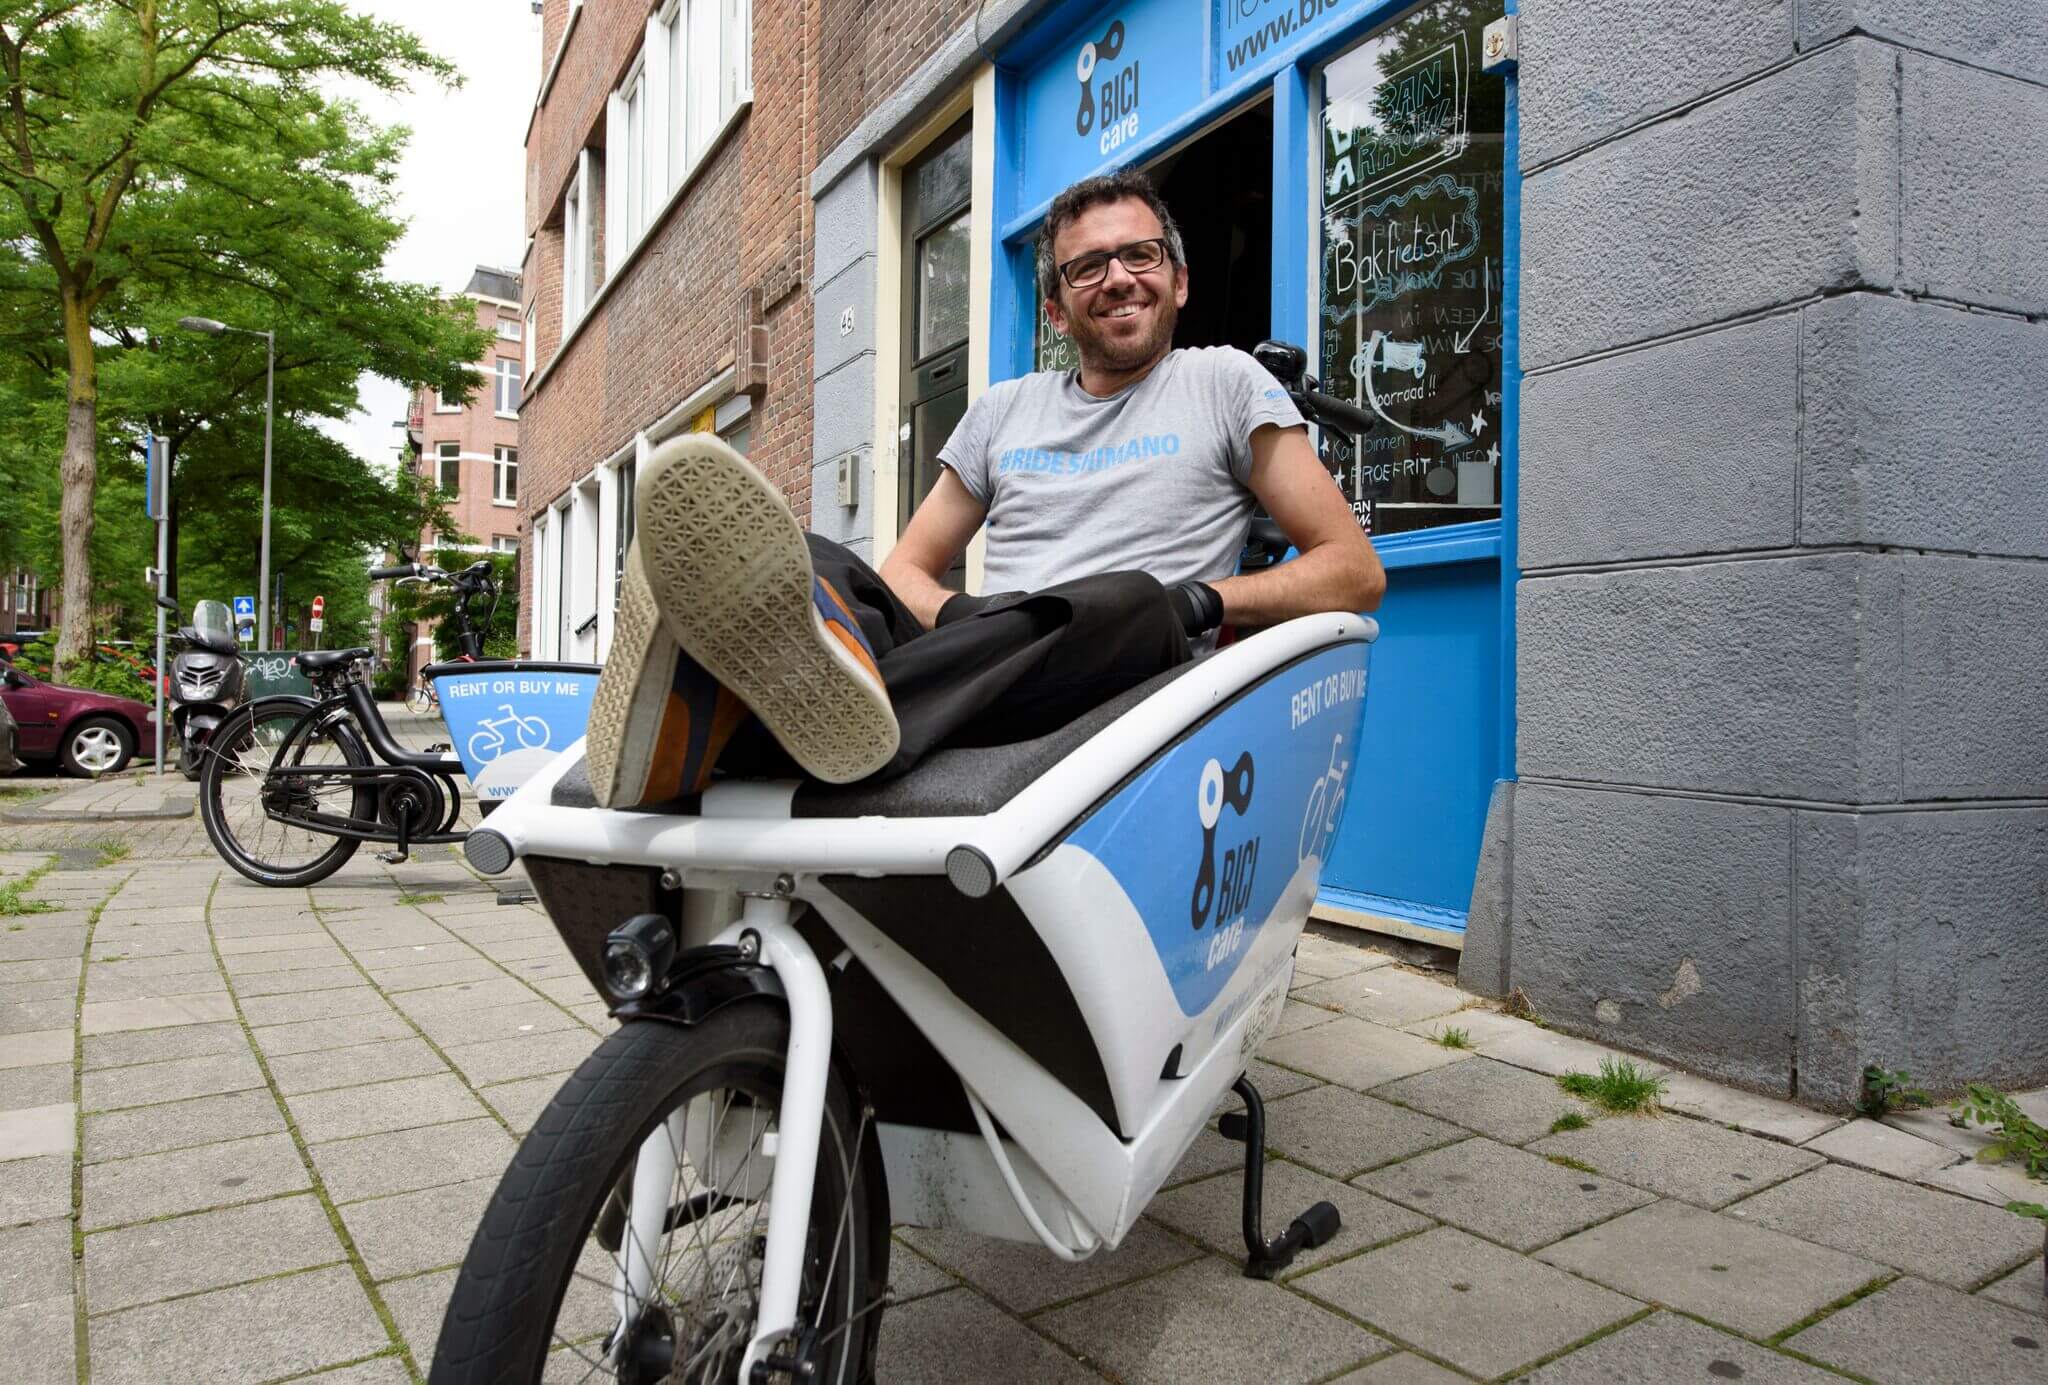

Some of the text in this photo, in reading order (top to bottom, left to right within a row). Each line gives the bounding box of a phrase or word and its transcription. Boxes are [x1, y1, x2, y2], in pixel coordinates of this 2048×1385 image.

[1101, 60, 1139, 130] BICI
[1100, 112, 1139, 156] care
[1375, 379, 1425, 407] oorraad
[449, 681, 579, 698] RENT OR BUY ME
[1291, 680, 1323, 730] RENT
[1324, 673, 1339, 708] OR
[1340, 670, 1357, 701] BUY
[1215, 836, 1260, 928] BICI
[1207, 916, 1245, 971] care
